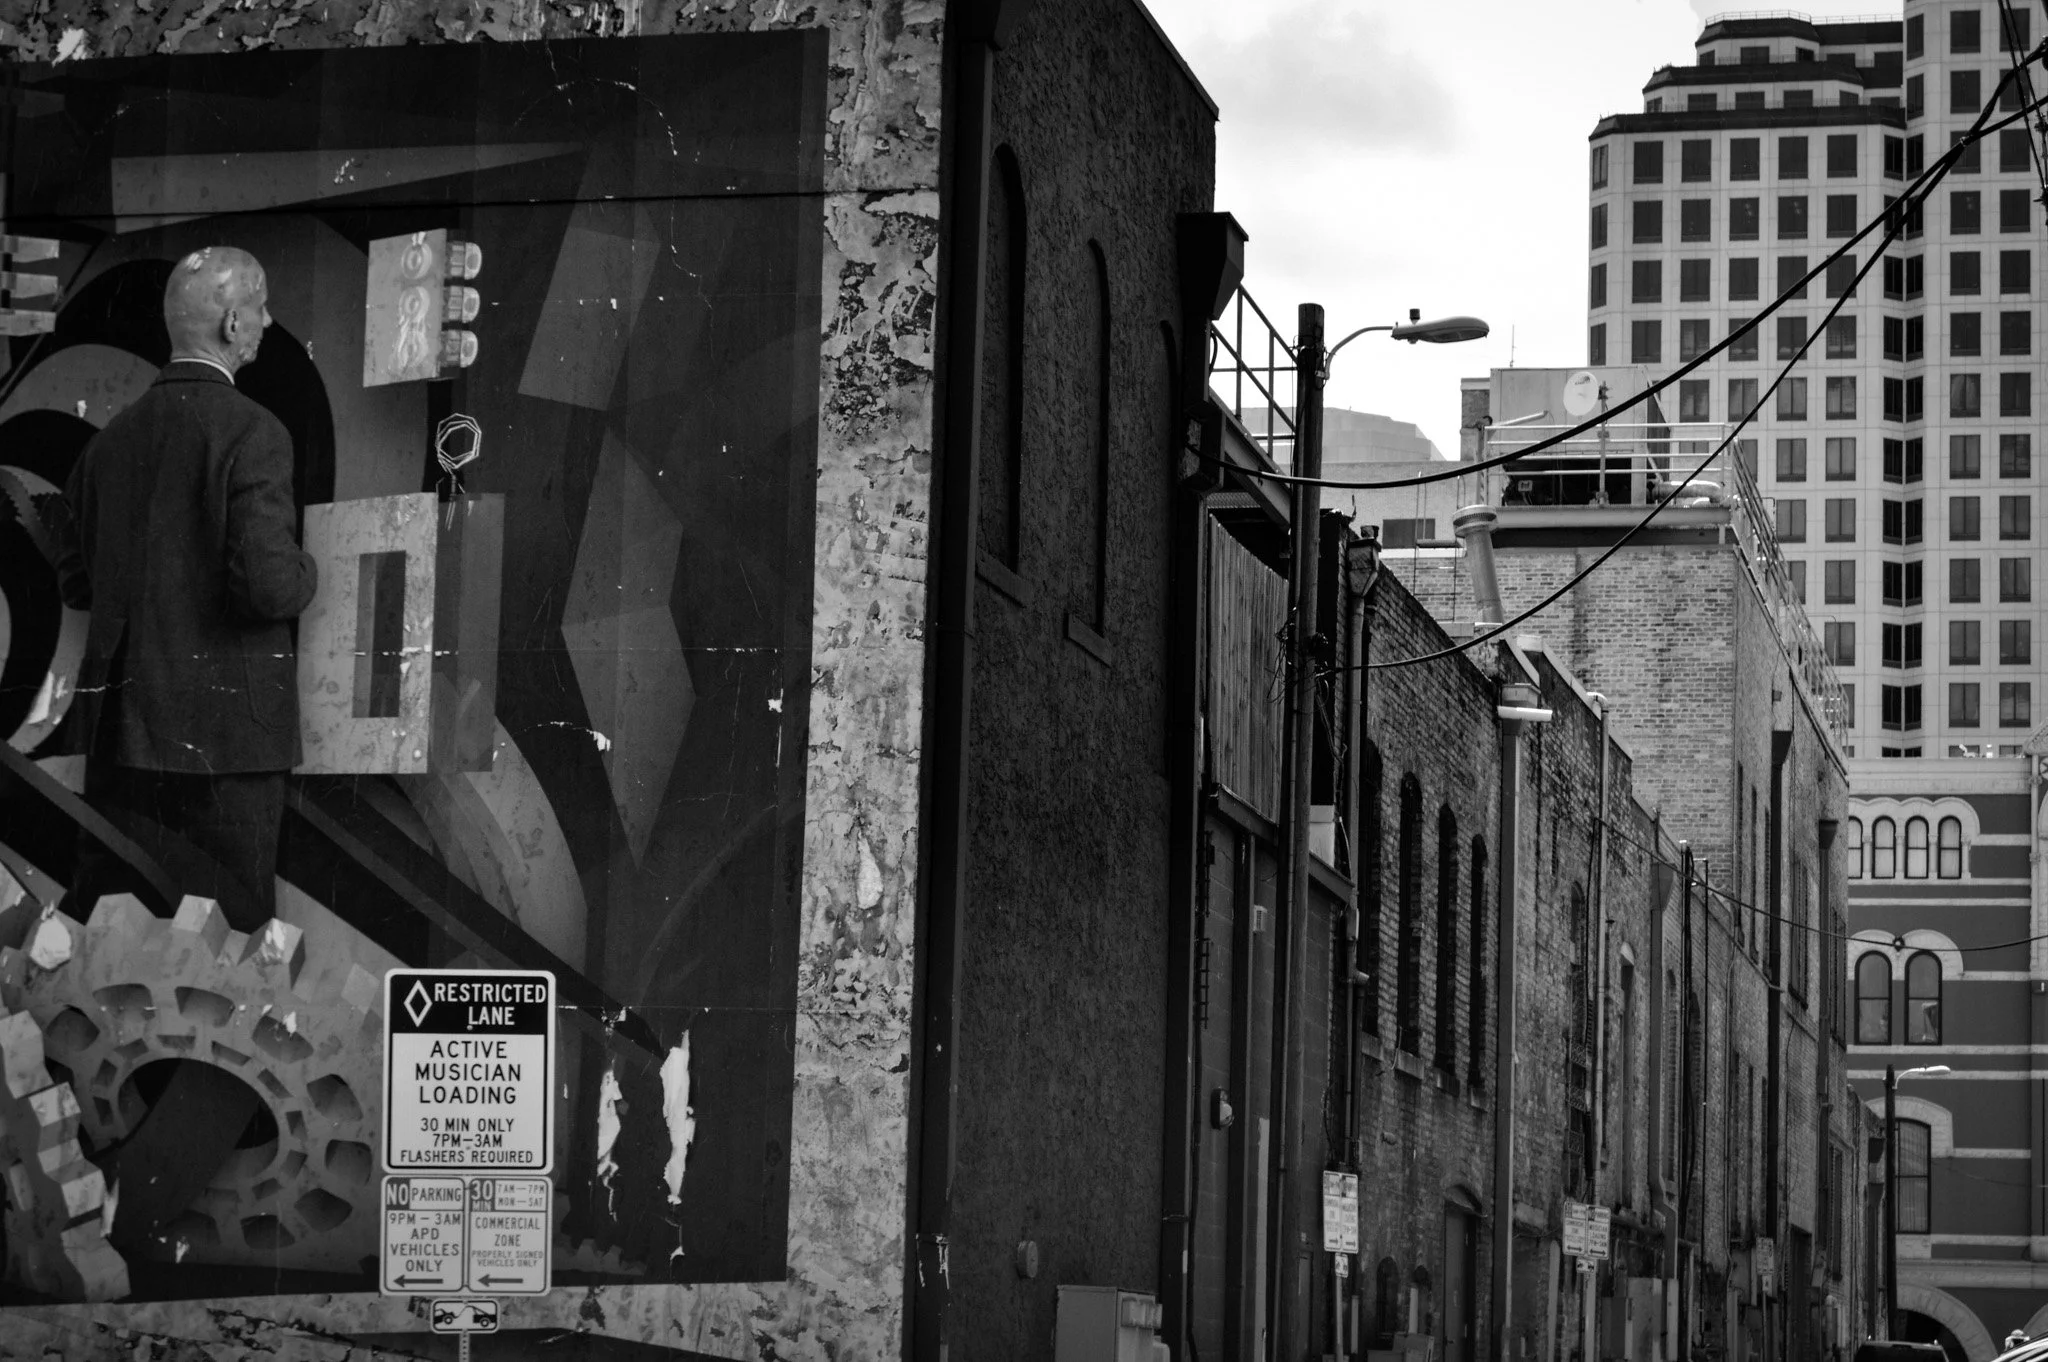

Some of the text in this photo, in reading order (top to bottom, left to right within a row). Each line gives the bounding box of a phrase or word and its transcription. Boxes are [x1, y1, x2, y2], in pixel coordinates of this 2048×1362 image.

[434, 983, 547, 1003] RESTRICTED
[468, 1006, 515, 1026] LANE
[430, 1040, 508, 1059] ACTIVE
[415, 1063, 521, 1081] MUSICIAN
[419, 1086, 516, 1104] LOADING
[421, 1117, 514, 1132] 30 MIN ONLY
[400, 1150, 533, 1164] FLASHERS REQUIRED
[386, 1183, 461, 1205] NO PARKING
[471, 1180, 493, 1200] 30
[472, 1200, 492, 1212] MIN
[389, 1212, 416, 1225] 9PM
[434, 1213, 461, 1225] 3AM
[475, 1216, 540, 1230] COMMERCIAL
[410, 1227, 440, 1240] APD
[494, 1233, 521, 1247] ZONE
[390, 1243, 460, 1256] VEHICLES
[471, 1250, 512, 1259] PROPERLY
[405, 1259, 443, 1272] ONLY
[477, 1259, 539, 1268] VEHICLES ONLY
